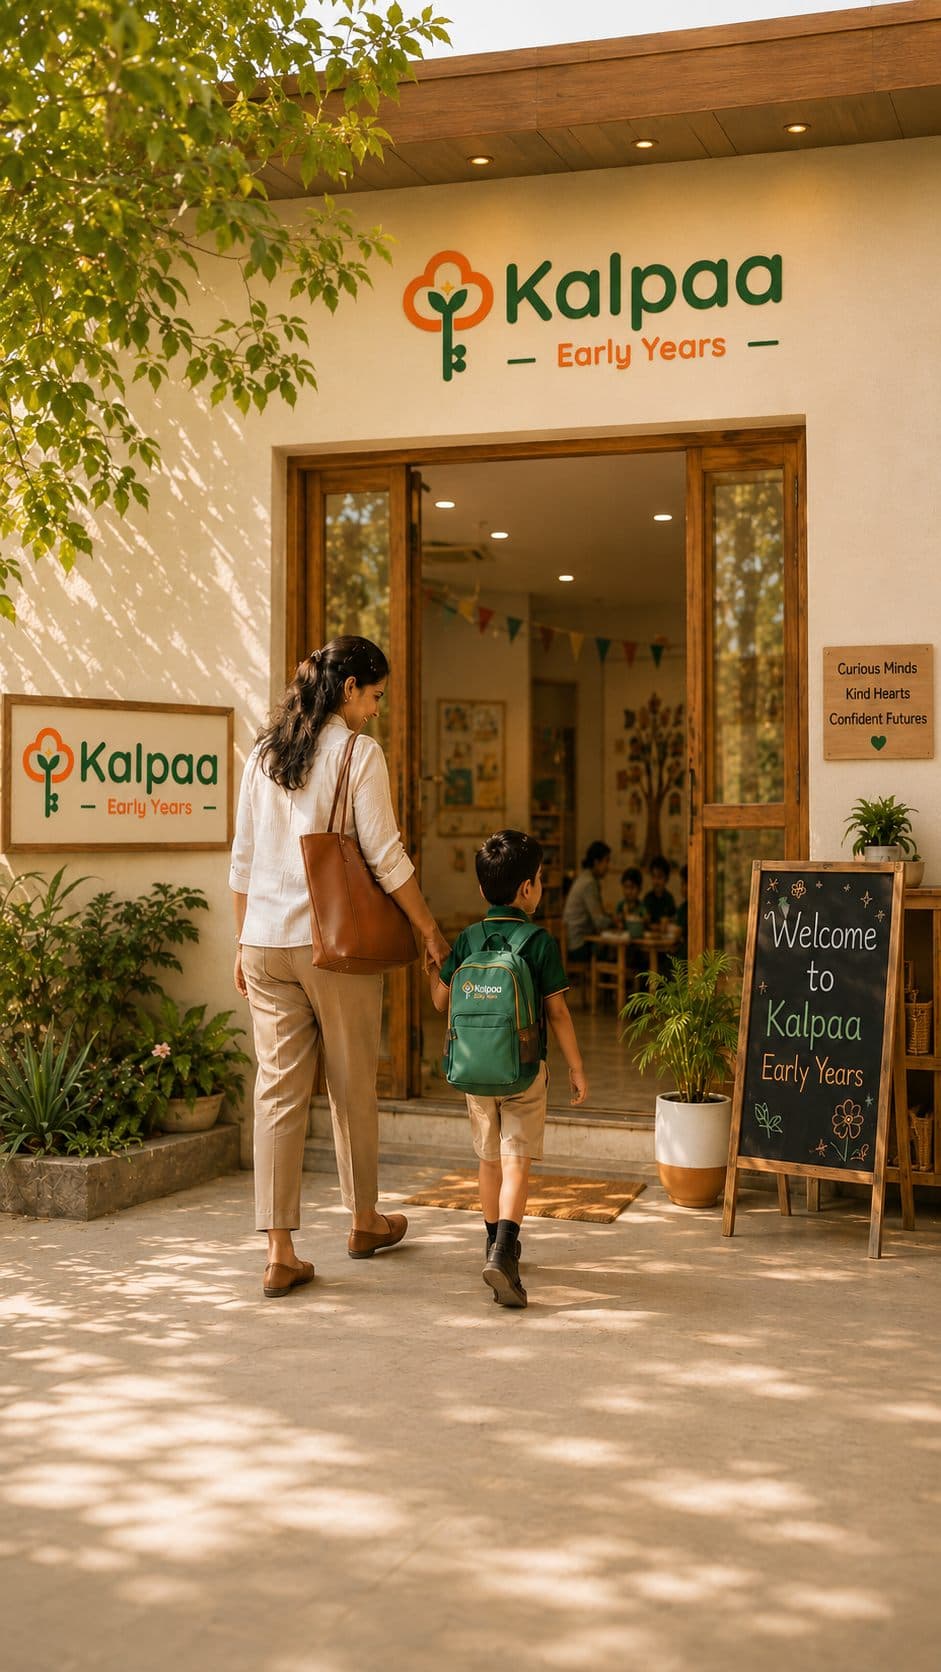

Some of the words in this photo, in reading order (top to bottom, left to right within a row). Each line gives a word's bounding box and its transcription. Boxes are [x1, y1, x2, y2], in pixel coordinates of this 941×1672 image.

[506, 252, 783, 331] Kalpaa
[557, 339, 632, 370] Early
[641, 336, 726, 361] Years
[837, 662, 881, 675] Curious
[883, 661, 918, 675] Minds
[845, 687, 871, 700] Kind
[873, 687, 911, 700] Hearts
[829, 712, 884, 726] Confident
[886, 711, 928, 725] Futures
[80, 740, 219, 796] Kalpaa
[106, 798, 147, 820] Early
[150, 798, 193, 817] Years
[764, 910, 877, 951] Welcome
[806, 960, 834, 992] to
[765, 999, 862, 1051] Kalpaa
[761, 1053, 810, 1093] Early
[815, 1055, 864, 1088] Years
